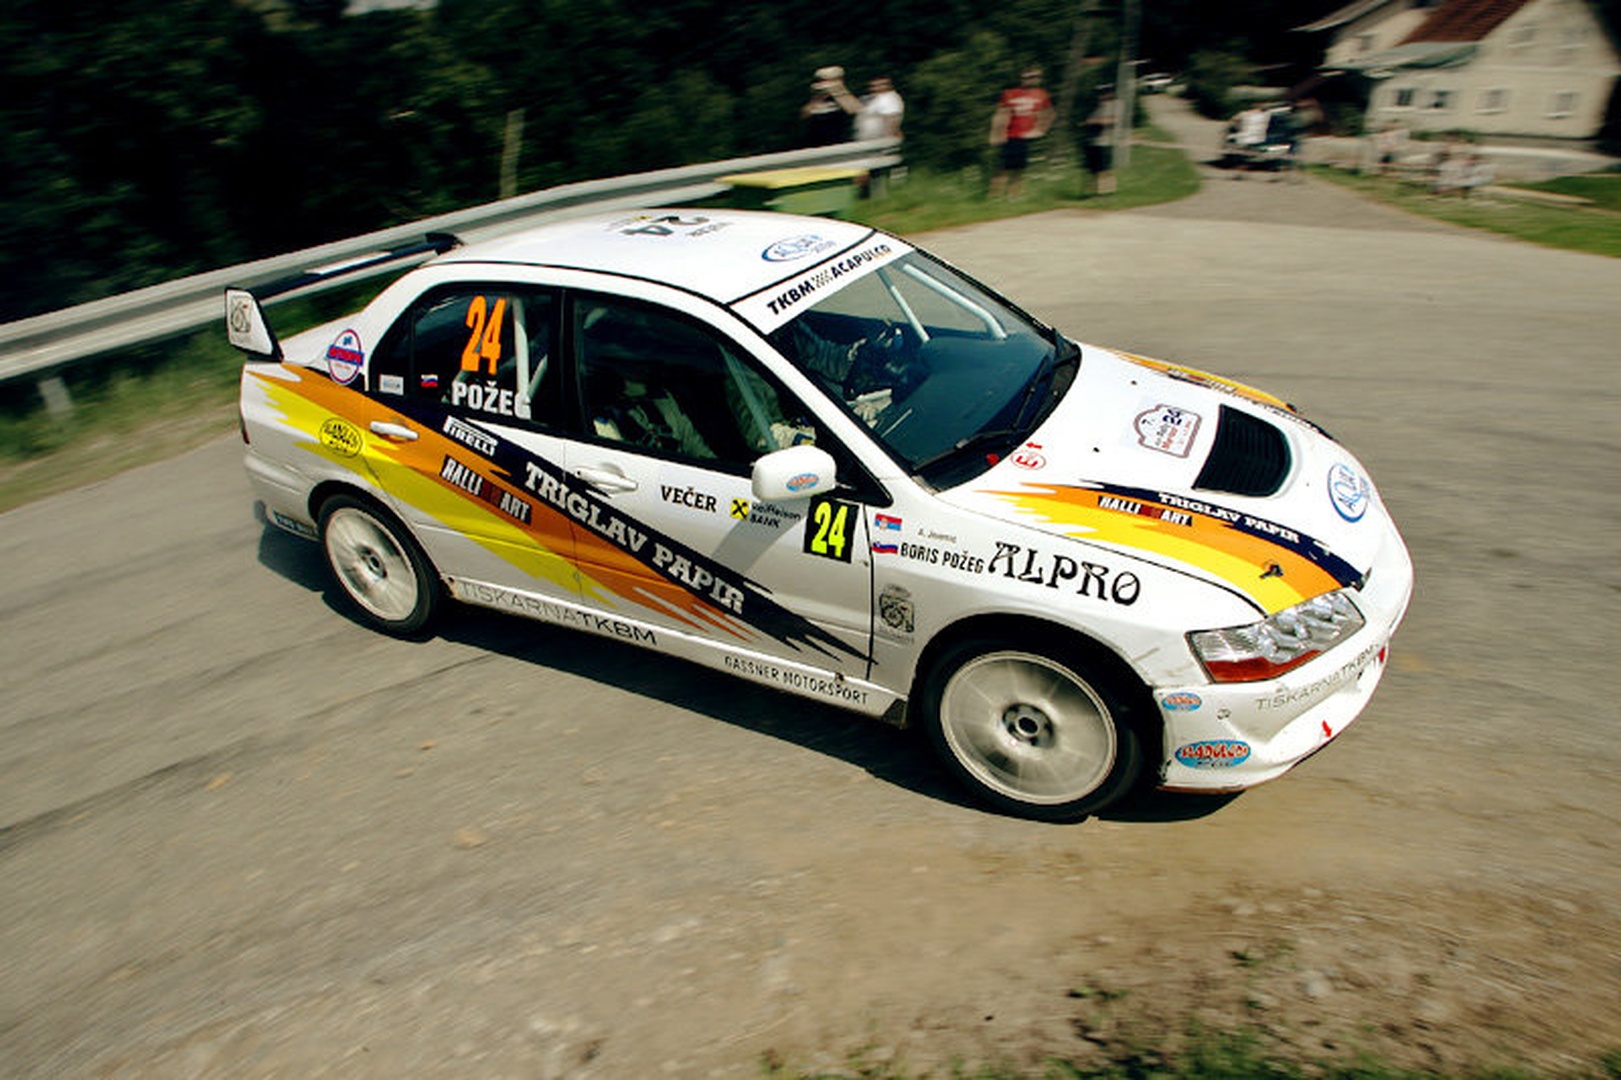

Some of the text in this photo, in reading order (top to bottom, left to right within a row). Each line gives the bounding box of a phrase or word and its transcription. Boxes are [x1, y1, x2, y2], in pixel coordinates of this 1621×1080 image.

[766, 280, 816, 315] TKBM
[830, 244, 892, 279] ACAPULCO
[460, 295, 506, 375] 24
[451, 380, 532, 419] POŽEG
[442, 415, 498, 457] PIRELLI
[441, 458, 531, 522] RALLI ART
[660, 484, 717, 513] VEČER
[1099, 495, 1192, 526] RALLI ART
[525, 461, 745, 614] TRIGLAV PAPIR
[750, 512, 780, 528] BANK
[811, 501, 853, 558] 24
[1158, 492, 1300, 543] TRIGLAV PAPIR
[900, 542, 985, 574] BORIS POŽEG
[987, 540, 1141, 606] ALPRO
[724, 655, 869, 705] GASSNER MOTORSPORT
